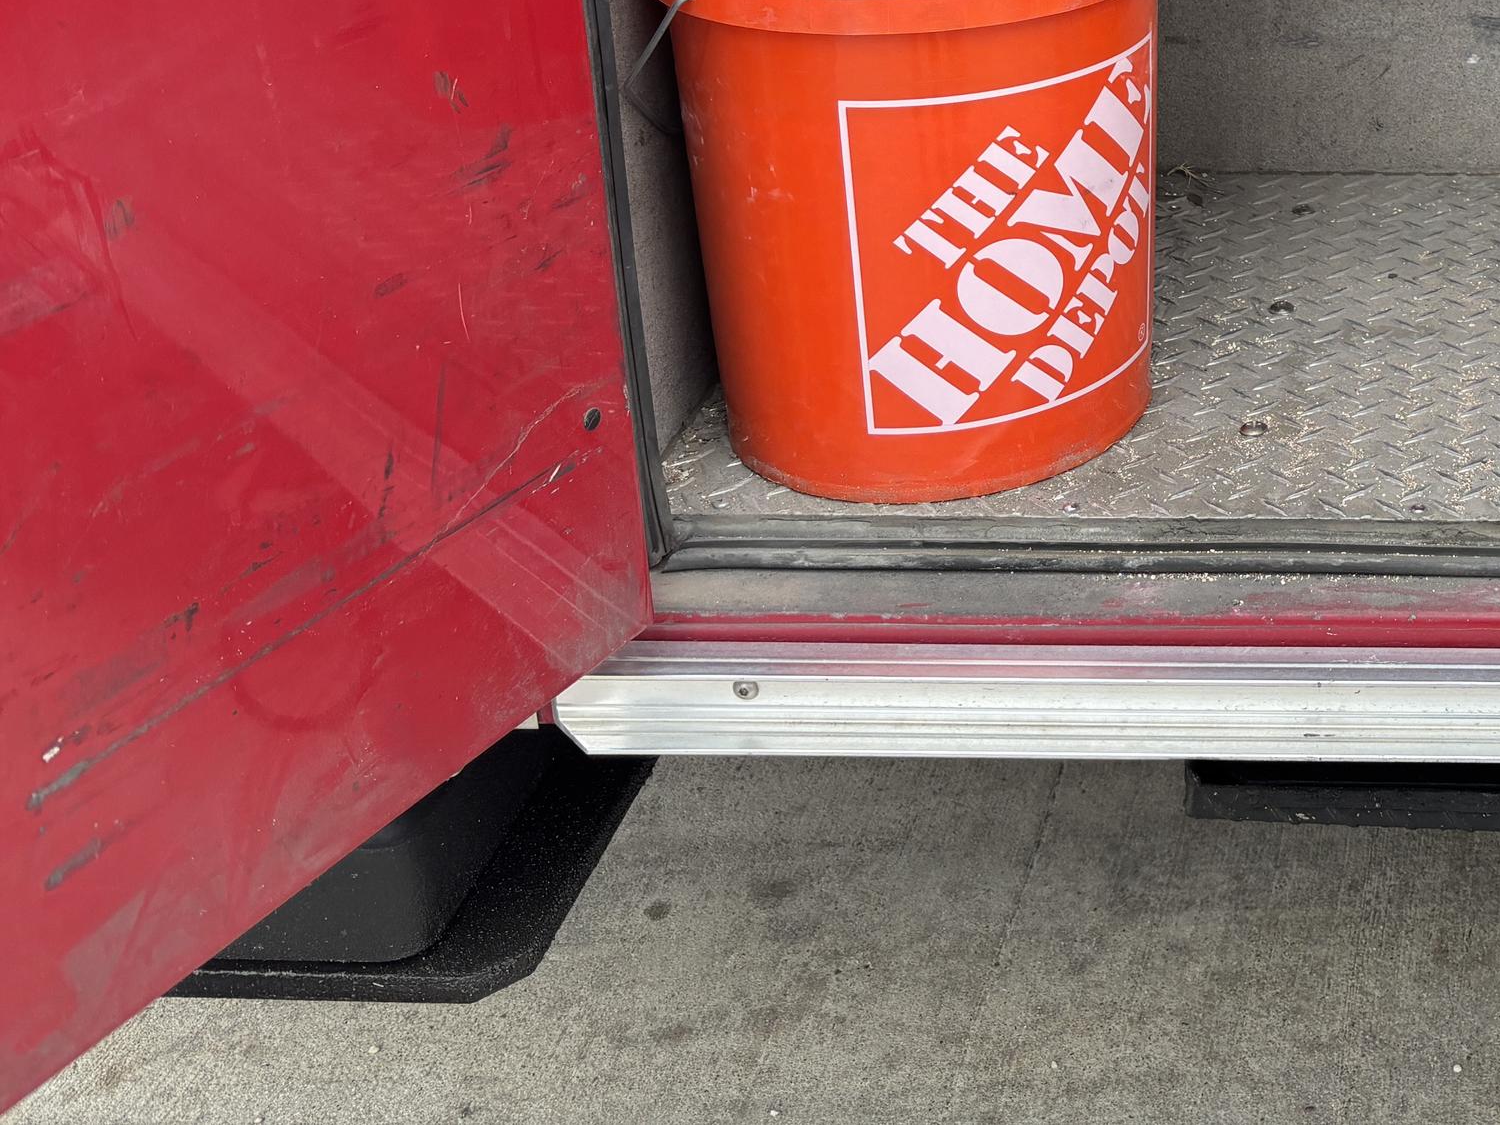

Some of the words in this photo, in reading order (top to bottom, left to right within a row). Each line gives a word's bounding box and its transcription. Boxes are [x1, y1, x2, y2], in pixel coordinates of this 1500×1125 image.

[869, 56, 1151, 426] HOME
[893, 125, 1050, 270] THE
[1011, 162, 1149, 403] DEPOT
